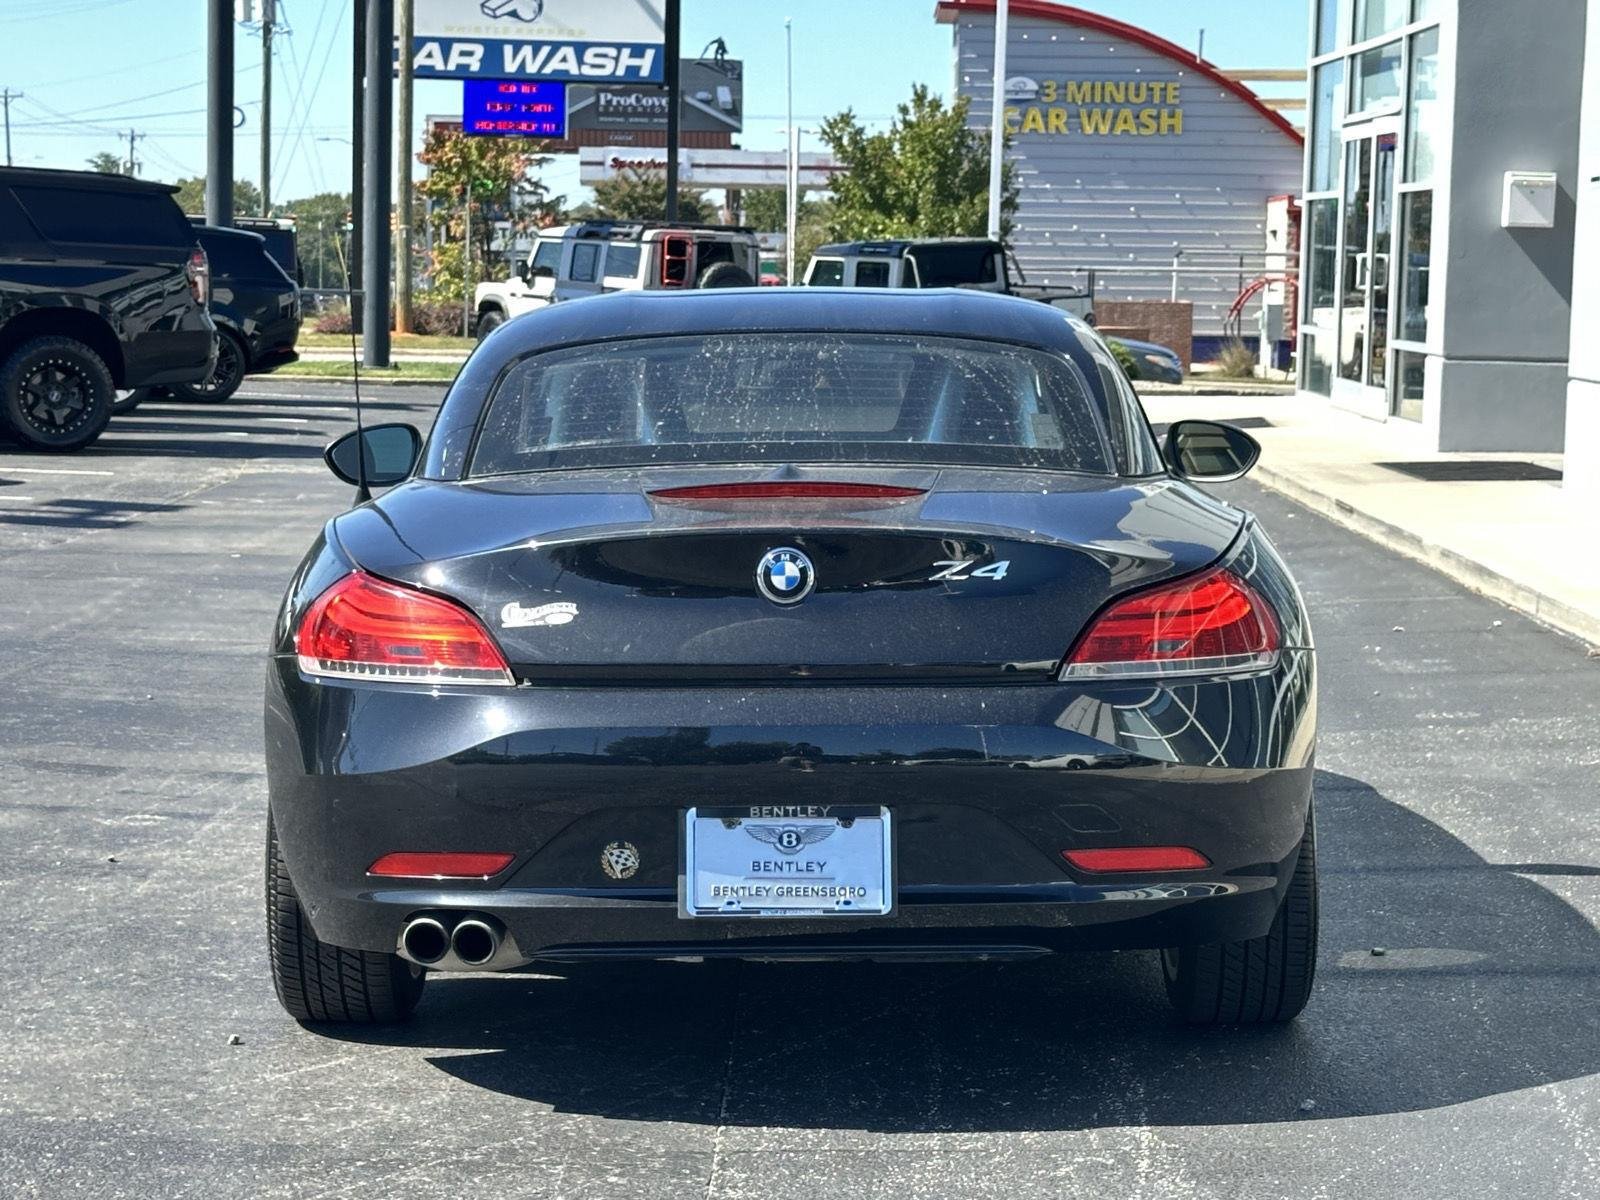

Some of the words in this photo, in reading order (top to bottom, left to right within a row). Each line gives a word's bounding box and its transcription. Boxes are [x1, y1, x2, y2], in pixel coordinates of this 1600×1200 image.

[393, 40, 485, 73] AR
[502, 44, 656, 78] WASH
[598, 92, 669, 107] ProCove
[1041, 80, 1058, 103] 3
[1066, 81, 1181, 105] MINUTE
[1003, 106, 1069, 135] CAR
[1079, 108, 1184, 136] WASH
[766, 553, 806, 569] BMW
[929, 560, 1011, 581] Z4
[750, 805, 831, 818] BENTLEY
[752, 861, 827, 873] BENTLEY
[712, 885, 772, 898] BENTLEY
[775, 885, 867, 899] GREENSBORO
